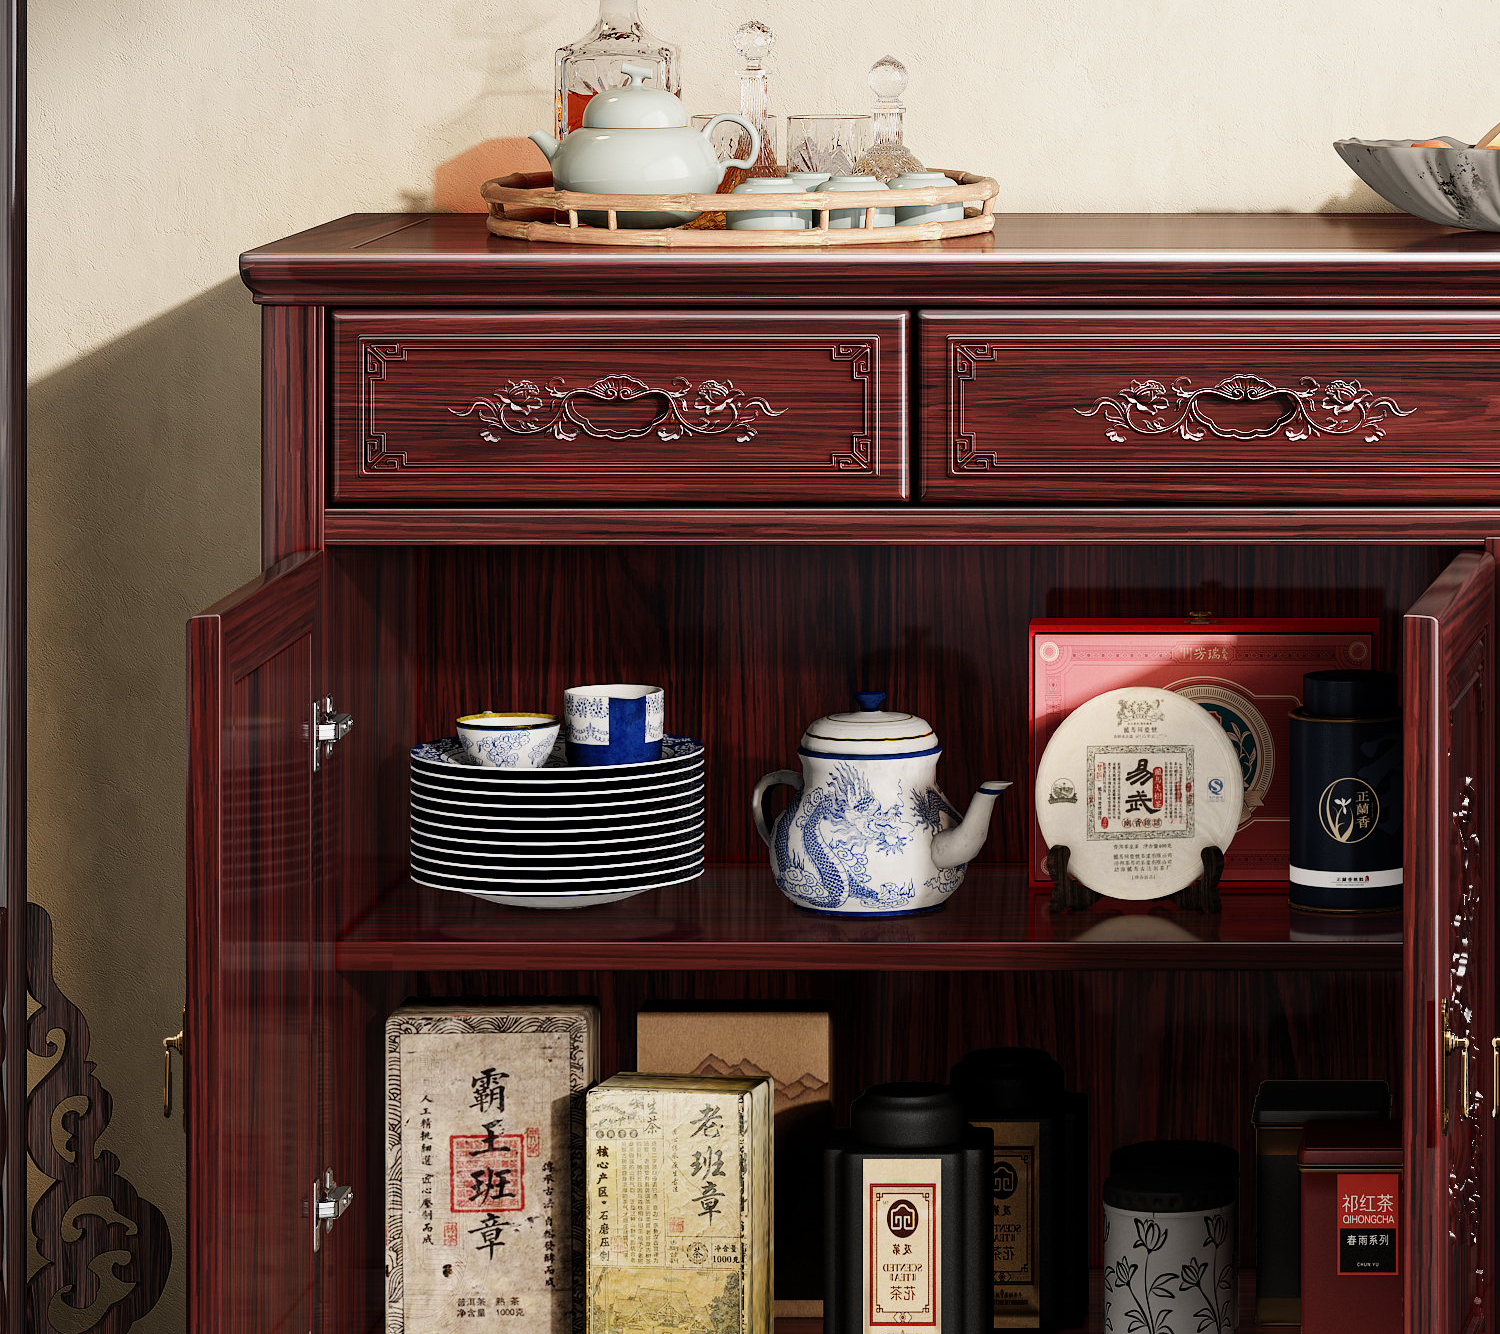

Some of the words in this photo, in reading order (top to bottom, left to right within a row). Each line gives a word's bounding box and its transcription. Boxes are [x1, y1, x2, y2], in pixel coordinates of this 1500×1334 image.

[1125, 759, 1161, 814] 易武
[1355, 790, 1371, 829] 正蘭香
[463, 1067, 516, 1261] 霸王班章
[689, 1102, 727, 1227] 老班章
[1342, 1194, 1394, 1213] 祁红茶
[1342, 1214, 1395, 1224] QIHONGCHA
[1346, 1234, 1389, 1246] 春雨系列
[712, 1253, 740, 1264] 1000克
[457, 1296, 487, 1307] 普洱茶
[496, 1308, 526, 1318] 1000克
